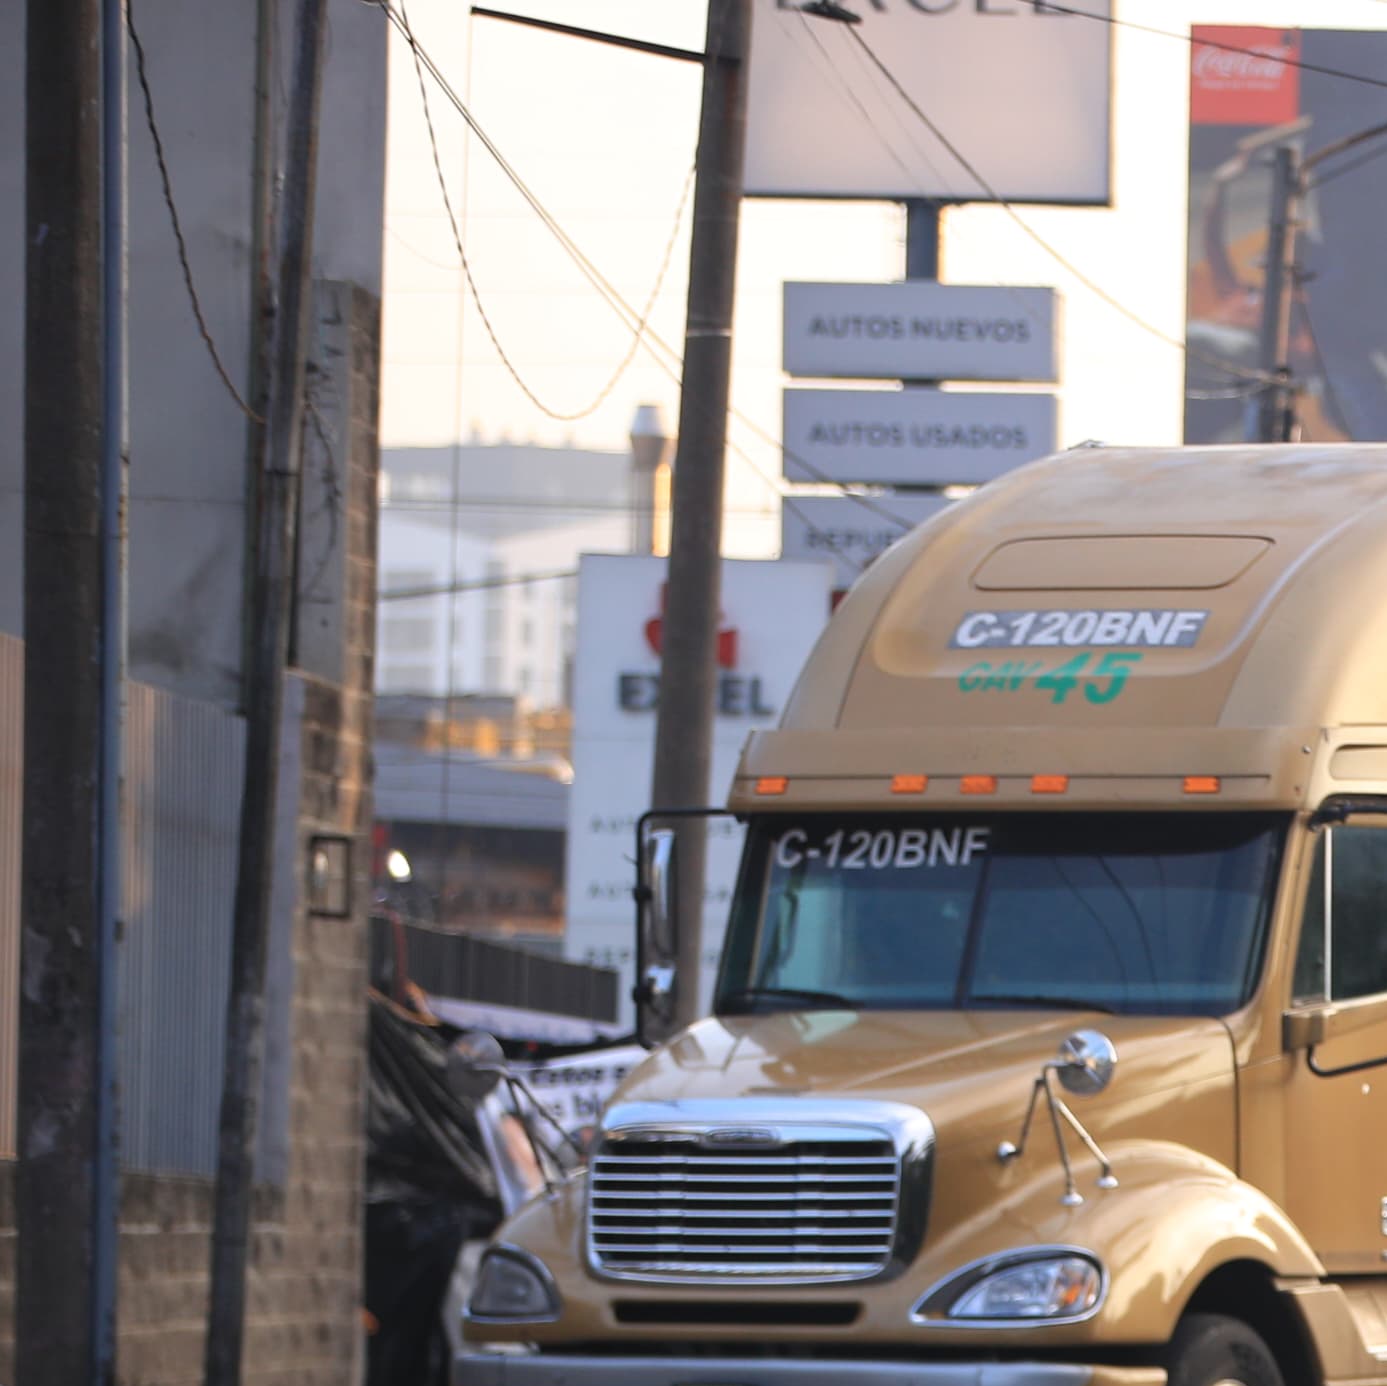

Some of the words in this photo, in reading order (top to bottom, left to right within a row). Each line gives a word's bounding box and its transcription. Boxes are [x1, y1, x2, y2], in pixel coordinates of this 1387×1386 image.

[808, 315, 904, 340] AUTOS
[910, 317, 1031, 344] NUEVOS
[808, 421, 904, 447] AUTOS
[910, 422, 1028, 450] USADOS
[956, 611, 1205, 647] C-120BNF
[1034, 651, 1144, 704] 45
[776, 828, 990, 868] C-120BNF
